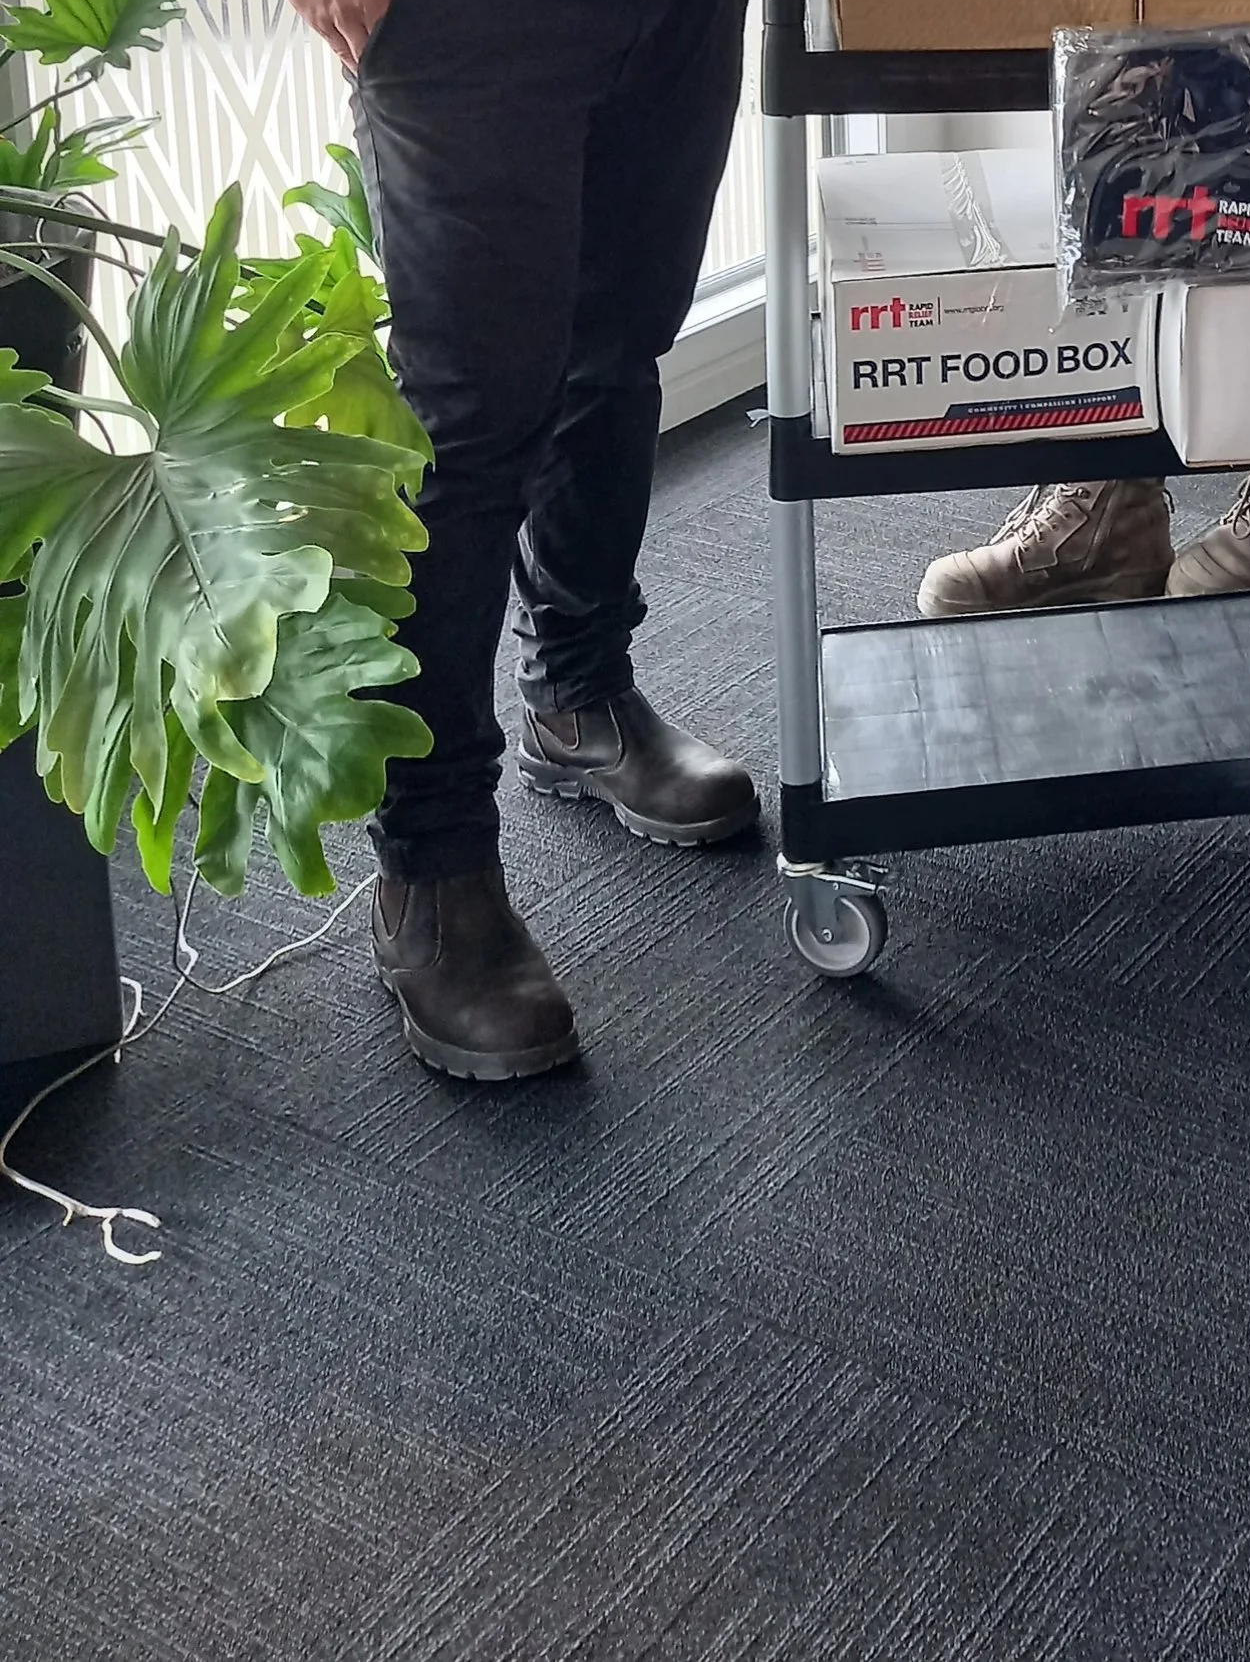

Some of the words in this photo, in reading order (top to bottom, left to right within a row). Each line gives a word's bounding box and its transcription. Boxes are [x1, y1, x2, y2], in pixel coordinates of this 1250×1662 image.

[1122, 185, 1218, 241] rrt
[851, 297, 906, 331] rrt
[908, 301, 934, 312] RAPID
[908, 310, 934, 320] RELIEF
[908, 319, 934, 329] TEAM
[853, 356, 931, 389] RRT
[941, 348, 1049, 384] FOOD
[1057, 338, 1133, 374] BOX
